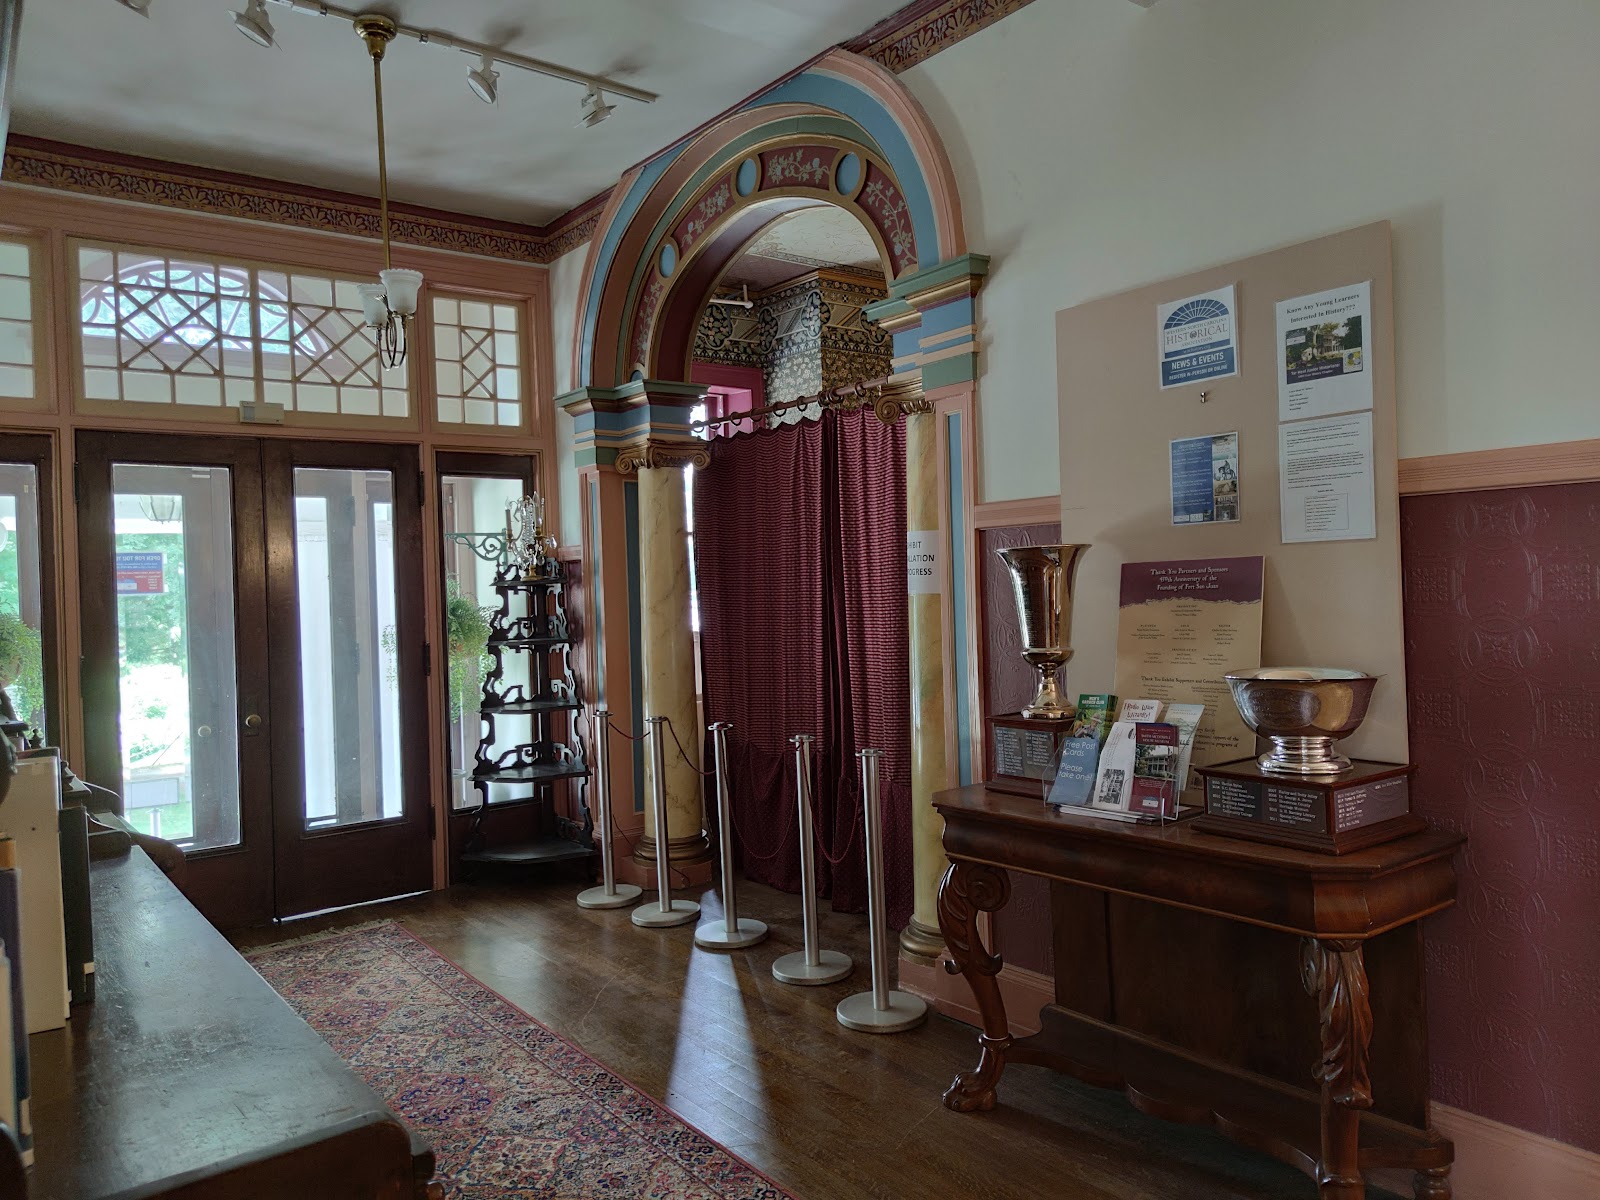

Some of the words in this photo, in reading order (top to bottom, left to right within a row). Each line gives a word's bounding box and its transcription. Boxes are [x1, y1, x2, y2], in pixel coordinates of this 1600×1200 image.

[1335, 294, 1359, 303] Learners
[1290, 313, 1316, 323] Interested
[1326, 304, 1356, 315] History???
[1204, 317, 1227, 327] CAROLINA
[1166, 324, 1228, 345] HISTORICAL
[1171, 359, 1191, 370] NEWS
[1192, 358, 1197, 366] &
[1199, 352, 1224, 365] EVENTS
[1214, 364, 1228, 372] ONLINE
[1066, 741, 1080, 749] Free
[1082, 742, 1096, 750] Post
[1065, 748, 1085, 757] Cards
[1061, 763, 1083, 773] Please
[1059, 771, 1074, 779] take
